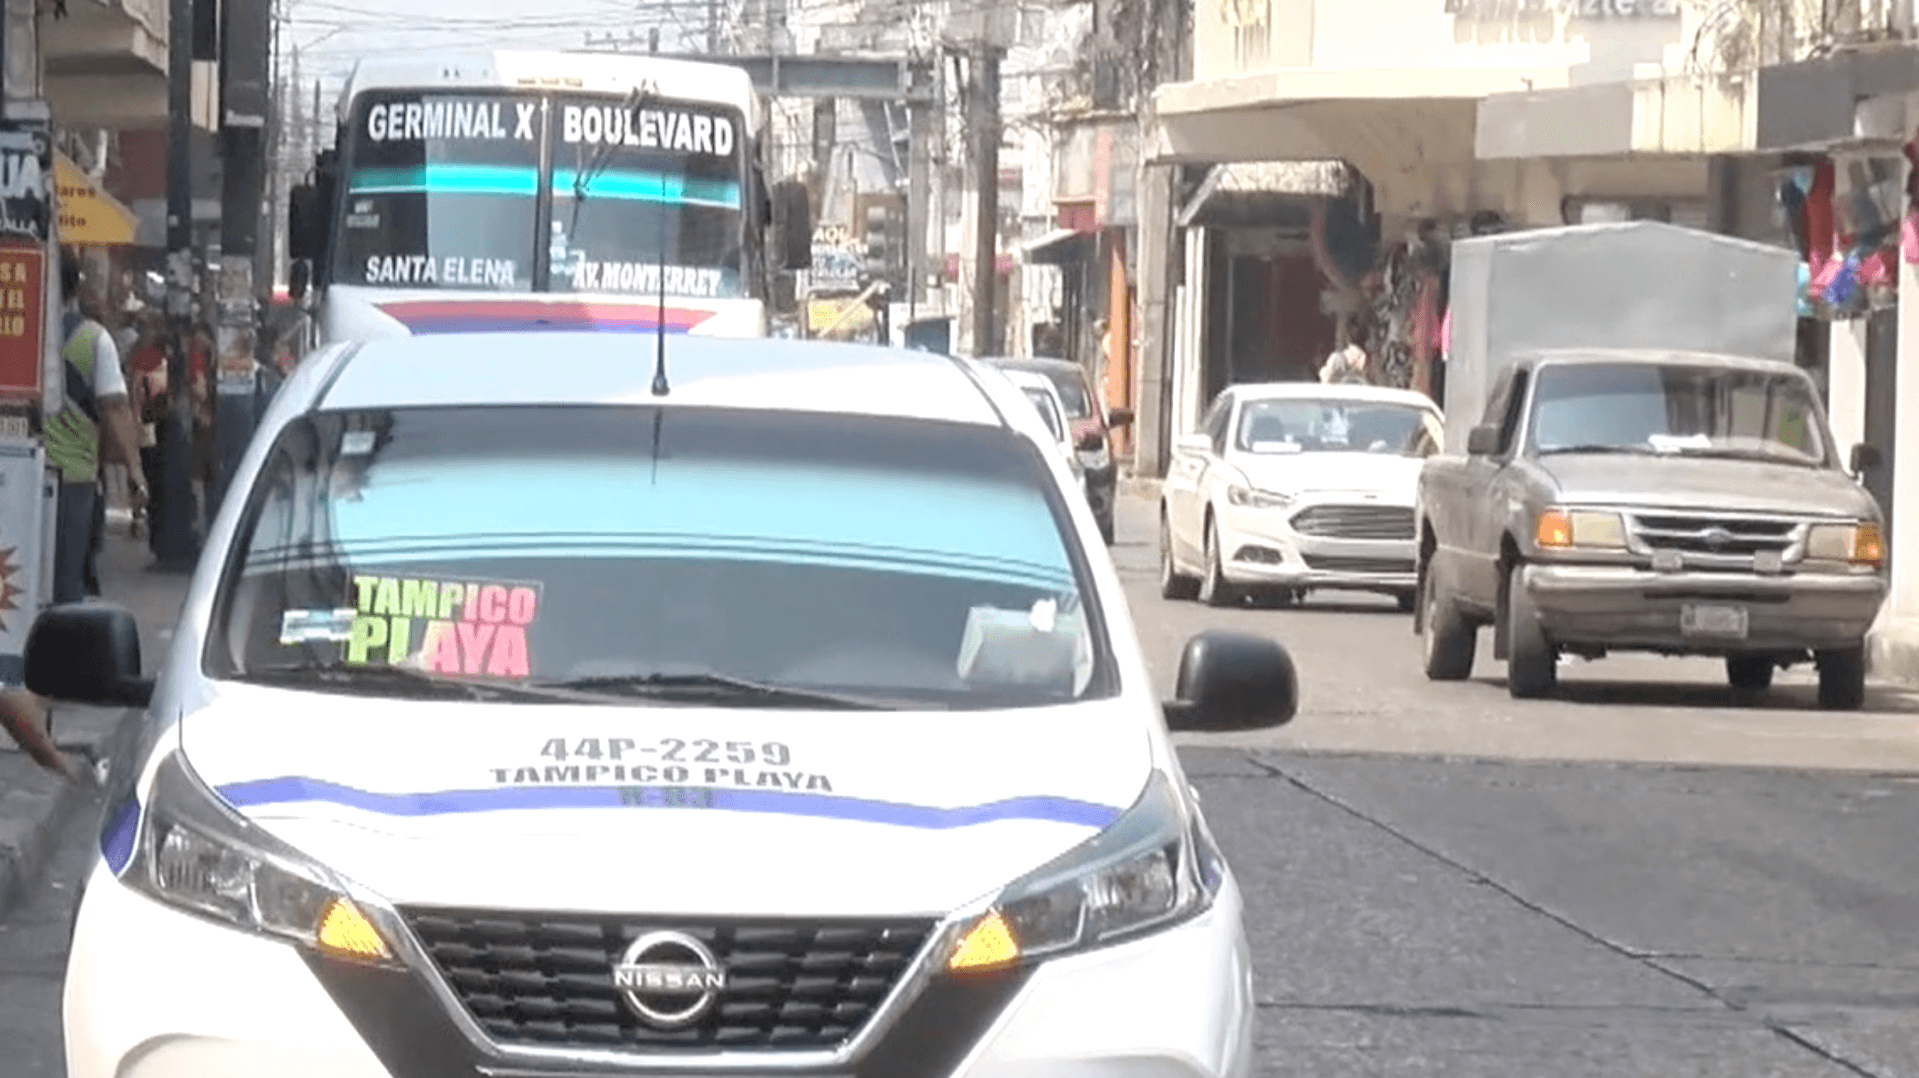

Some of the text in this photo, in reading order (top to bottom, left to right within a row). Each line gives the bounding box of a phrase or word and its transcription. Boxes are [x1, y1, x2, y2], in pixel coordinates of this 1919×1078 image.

[368, 103, 534, 140] GERMINAL X
[563, 106, 733, 156] BOULEVARD
[366, 256, 515, 285] SANTA ELENA
[572, 262, 721, 296] AV. MONTERREY
[353, 575, 537, 624] TAMPICO
[347, 615, 530, 677] PLAYA
[540, 737, 792, 767] 44P-2259
[489, 765, 833, 793] TAMPICO PLAYA
[614, 970, 724, 988] NISSAN
